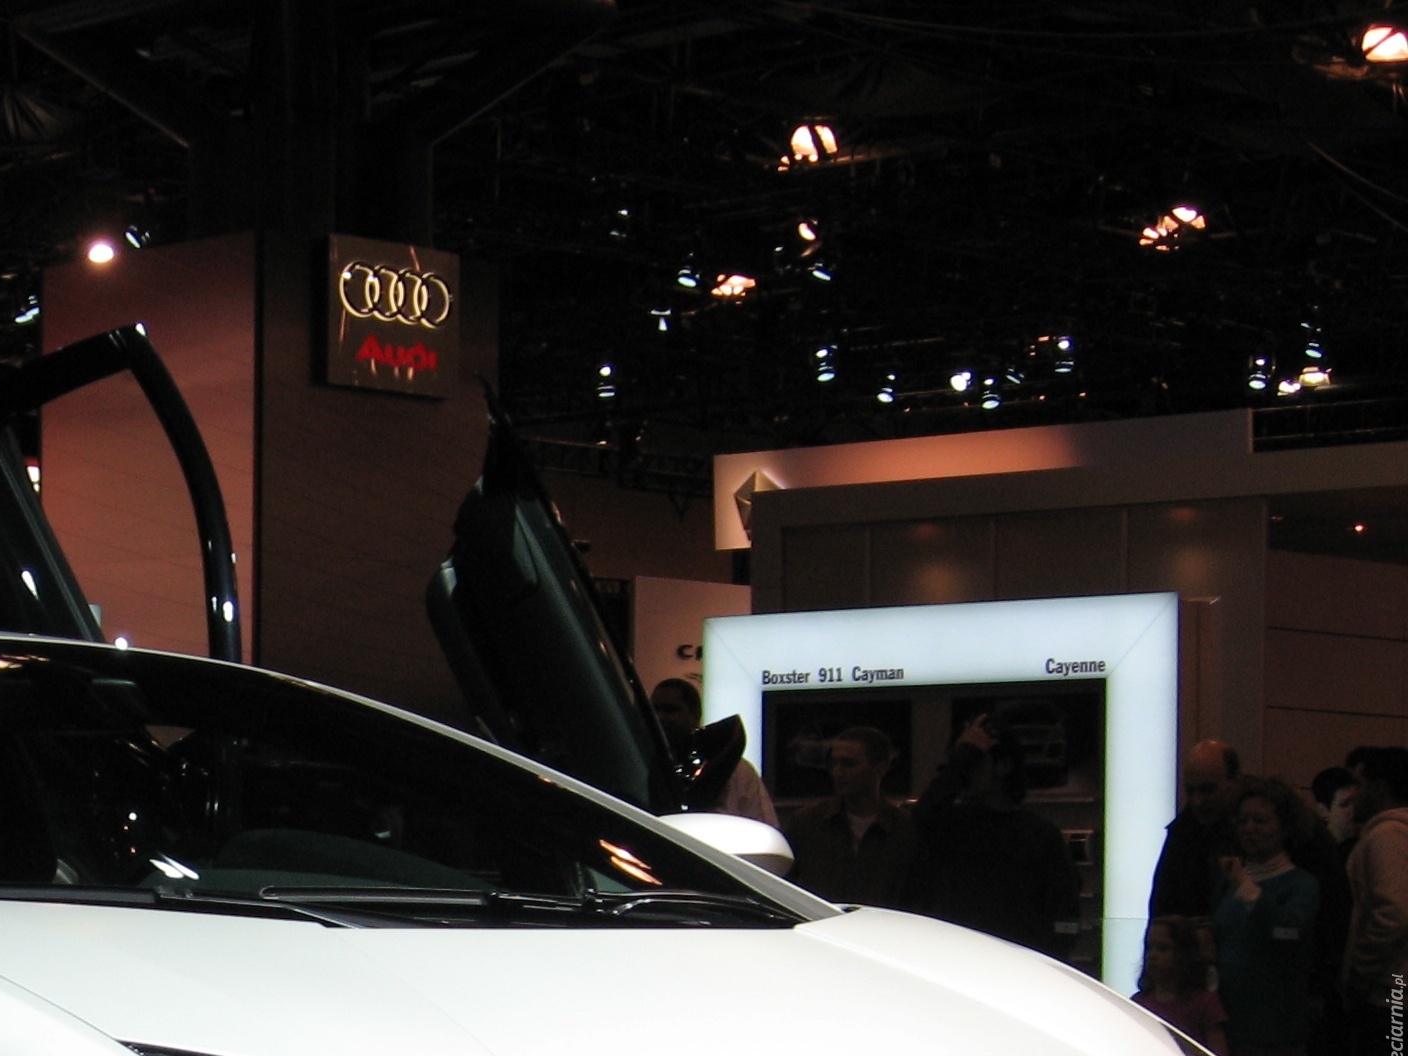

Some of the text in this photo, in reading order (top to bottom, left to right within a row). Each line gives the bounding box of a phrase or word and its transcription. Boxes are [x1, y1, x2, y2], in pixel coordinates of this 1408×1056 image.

[761, 666, 904, 685] Boxster 911 Cayman
[1045, 658, 1106, 676] Cayenne
